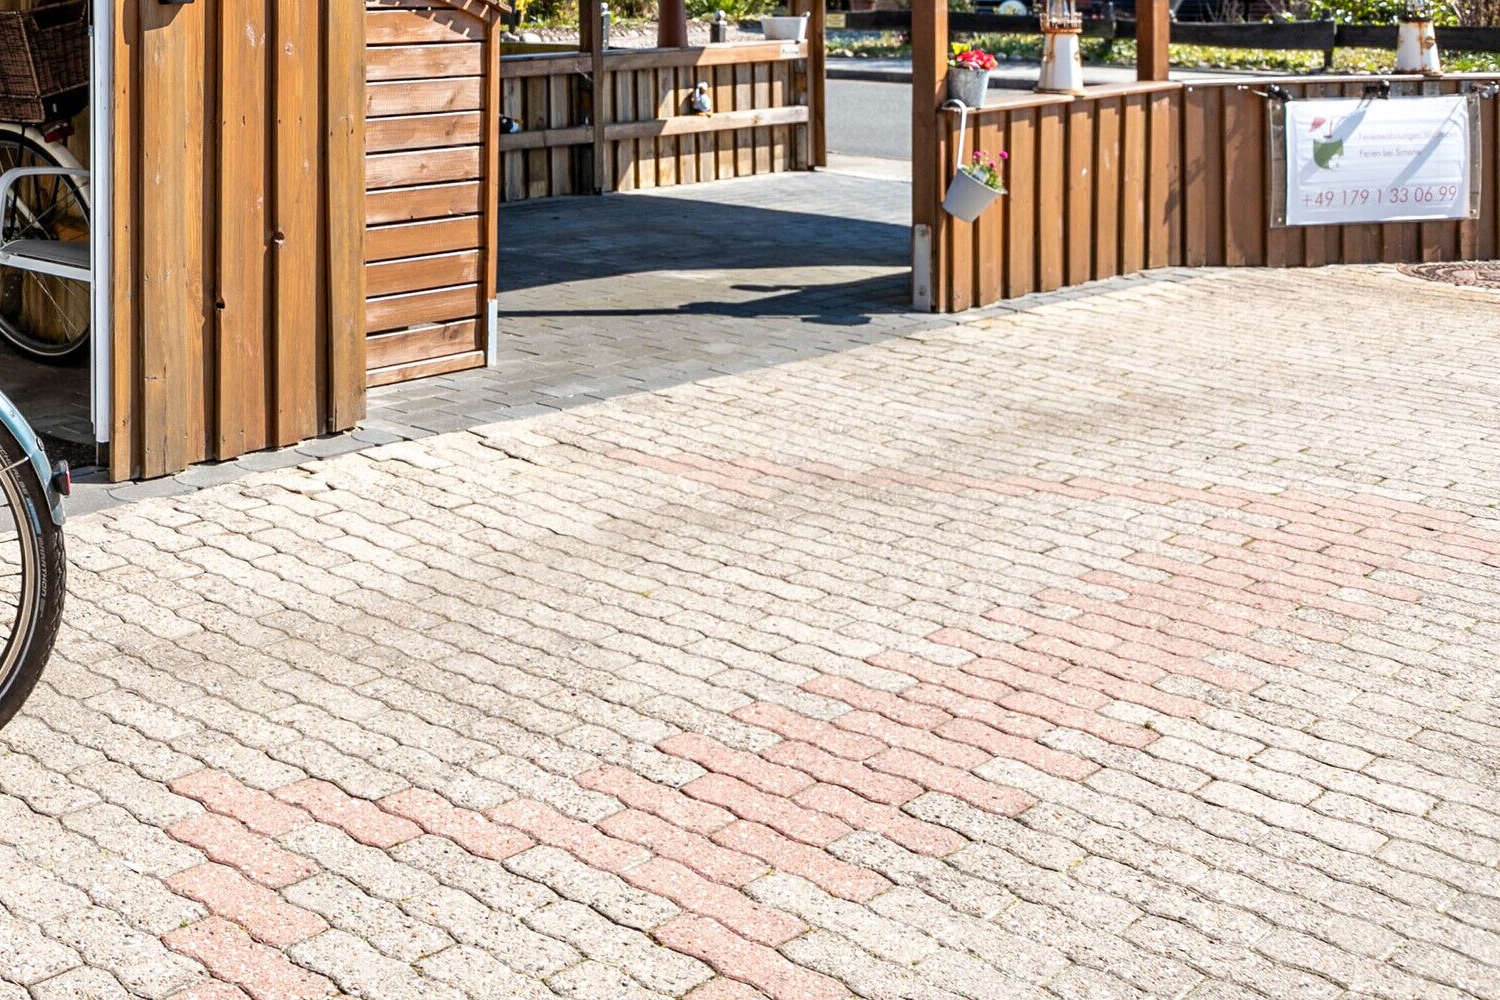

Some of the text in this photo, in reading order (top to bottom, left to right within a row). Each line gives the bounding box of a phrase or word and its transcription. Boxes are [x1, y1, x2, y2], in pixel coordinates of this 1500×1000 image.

[1359, 149, 1381, 158] Ferien
[1301, 185, 1458, 208] +49 179 1 33 06 99
